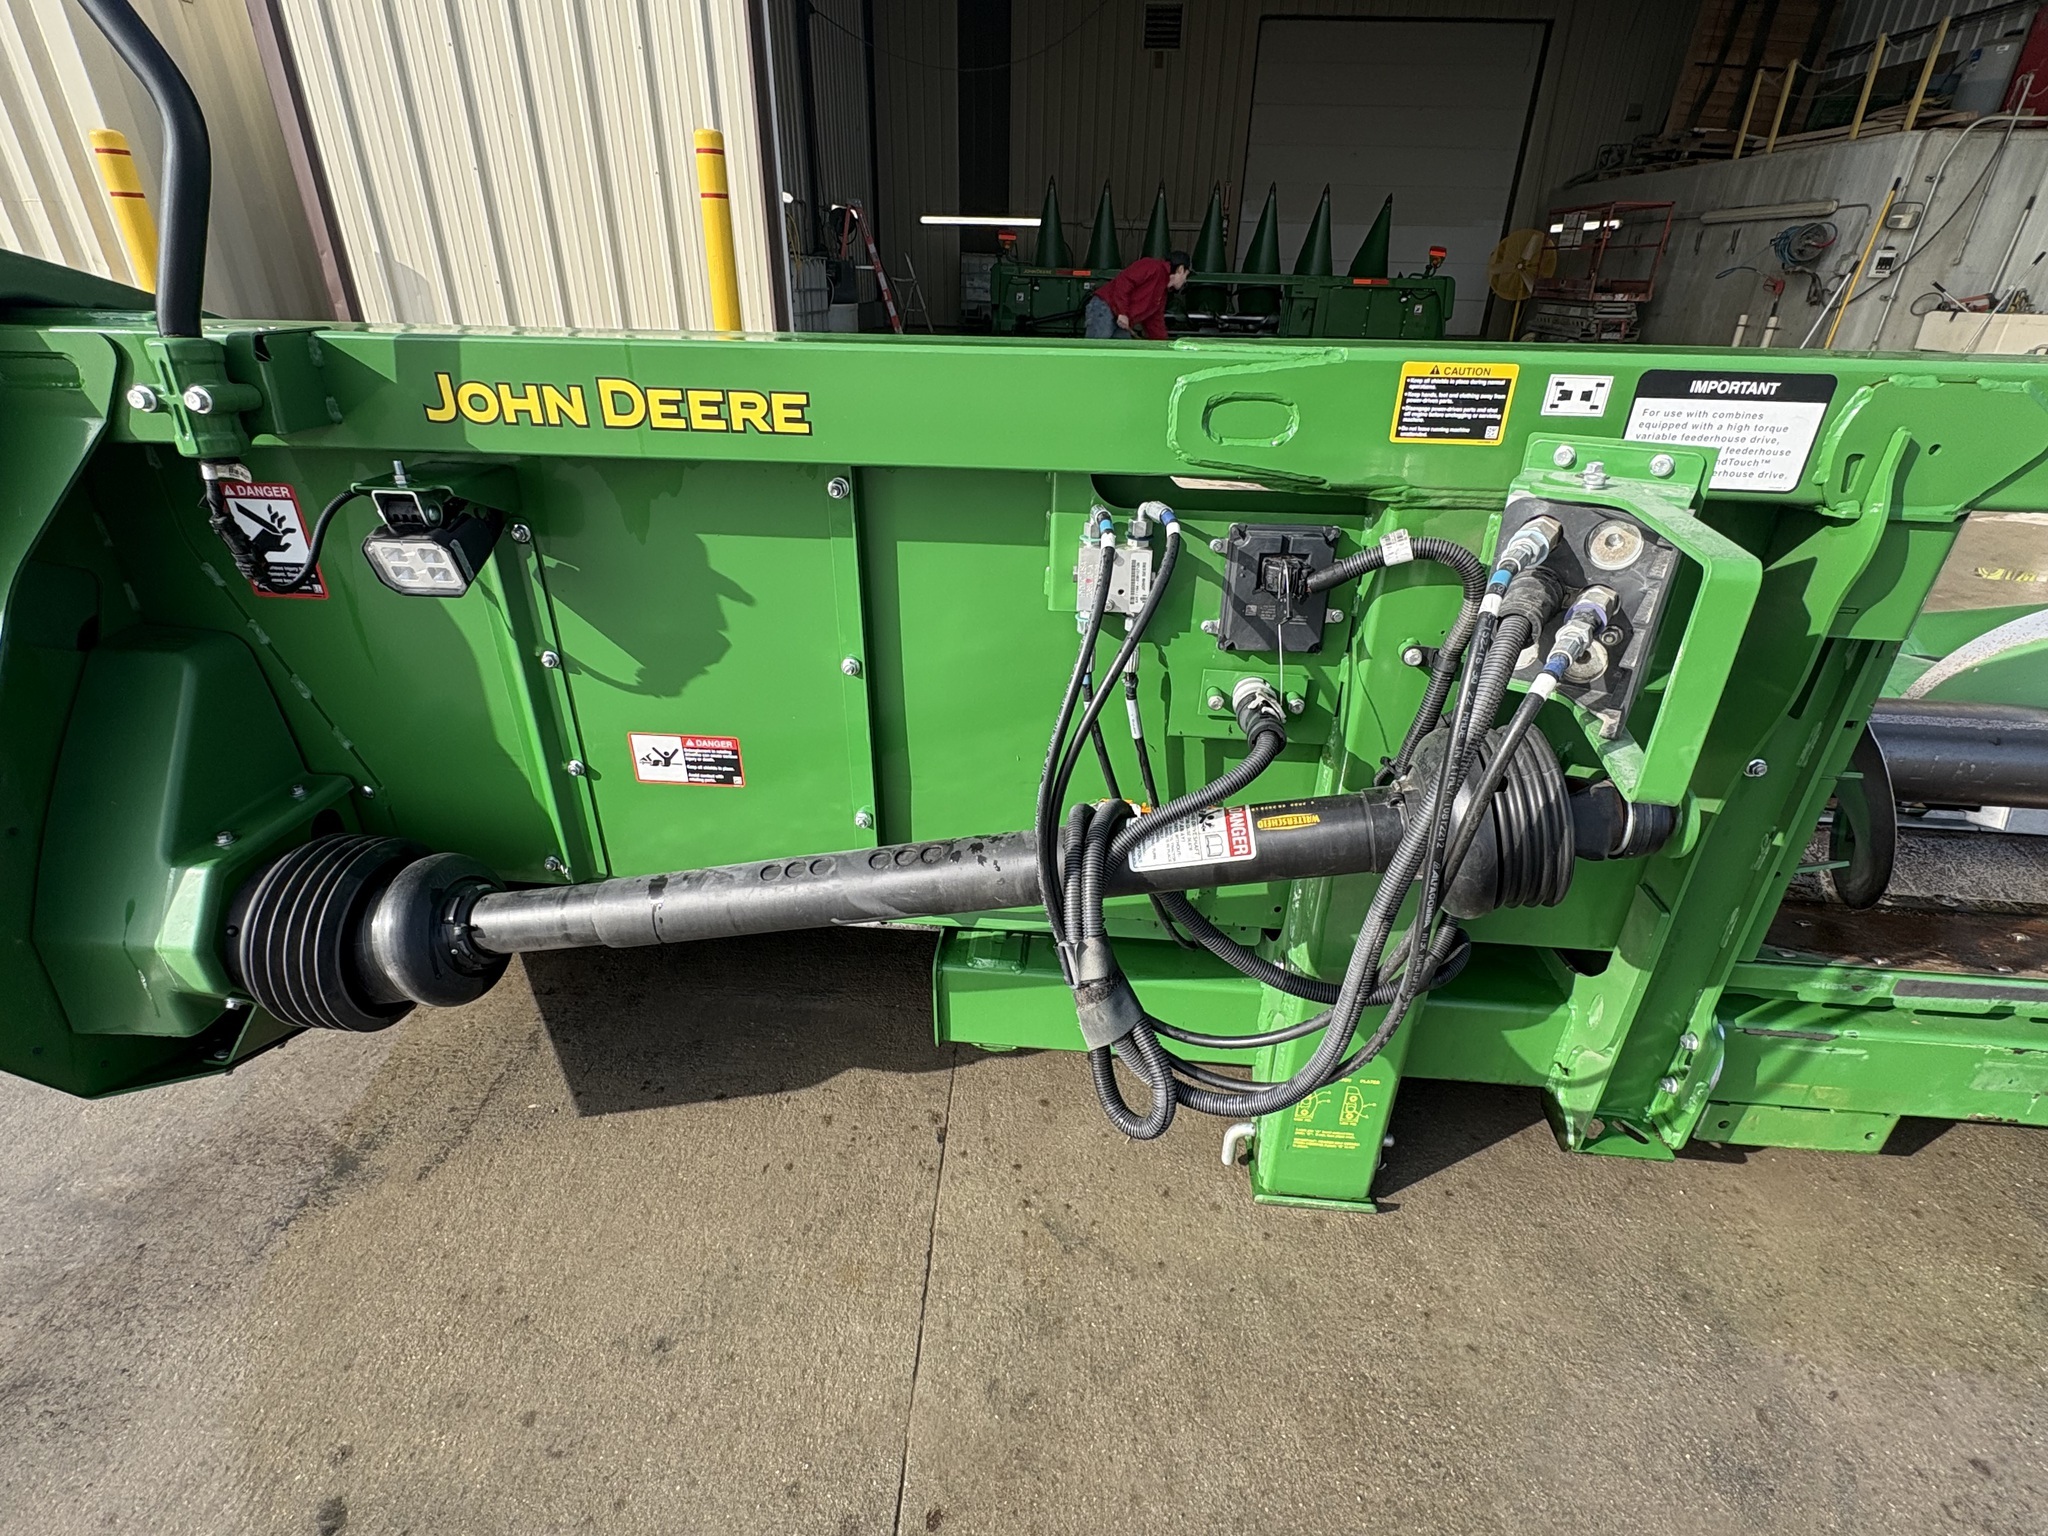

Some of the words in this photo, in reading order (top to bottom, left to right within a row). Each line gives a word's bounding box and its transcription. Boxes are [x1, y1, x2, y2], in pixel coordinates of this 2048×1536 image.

[1444, 366, 1491, 376] CAUTION
[1690, 380, 1781, 395] IMPORTANT
[423, 371, 590, 428] JOHN
[596, 376, 813, 436] DEERE
[1642, 408, 1660, 417] For
[1664, 410, 1683, 418] use
[1686, 410, 1708, 419] with
[1712, 411, 1764, 420] combines
[1639, 421, 1687, 431] equipped
[1691, 422, 1714, 431] with
[1726, 422, 1750, 433] high
[1754, 424, 1789, 434] torque
[1636, 433, 1677, 441] variable
[1681, 433, 1746, 443] feederhouse
[1750, 435, 1780, 446] drive,
[1725, 446, 1792, 457] feederhouse
[1713, 469, 1754, 479] erhouse
[236, 485, 291, 498] DANGER
[1457, 711, 1471, 739] MADE
[696, 740, 733, 748] DANGER
[1454, 745, 1463, 758] IN
[1446, 763, 1459, 796] ITALY
[1257, 813, 1321, 829] WALTERSCHEID
[1229, 805, 1250, 856] DANGER
